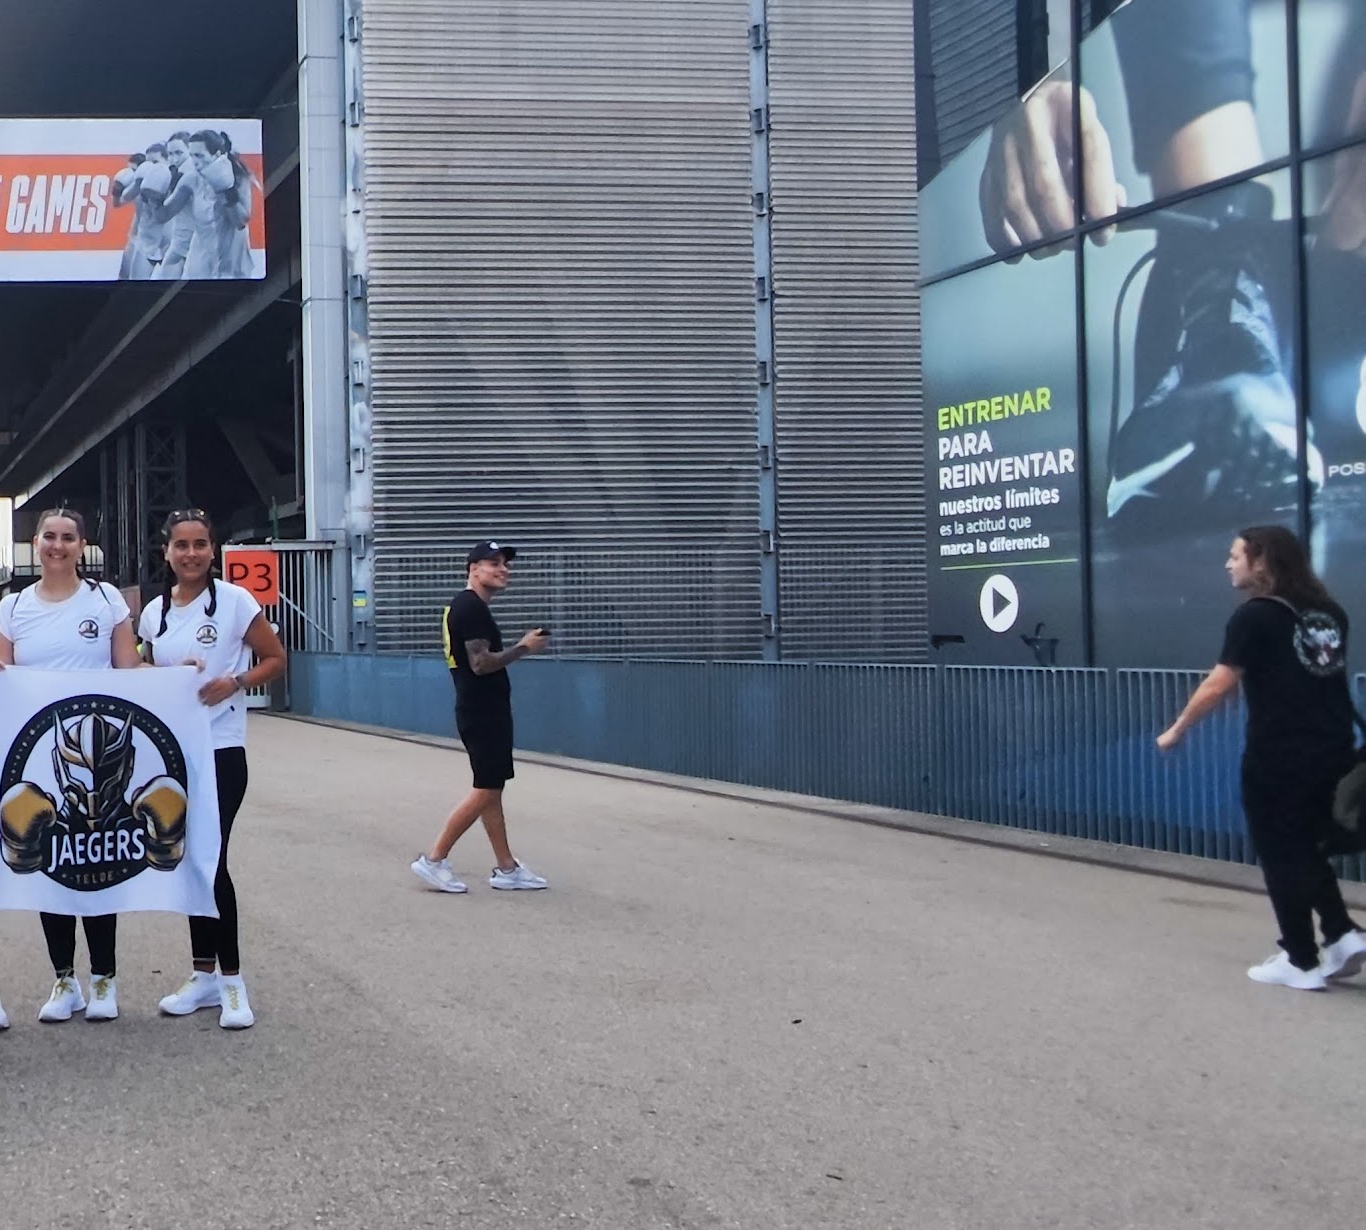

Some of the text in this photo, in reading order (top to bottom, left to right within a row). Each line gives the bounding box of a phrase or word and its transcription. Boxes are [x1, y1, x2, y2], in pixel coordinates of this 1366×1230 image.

[5, 174, 110, 234] GAMES
[937, 387, 1051, 431] ENTRENAR
[938, 430, 993, 461] PARA
[938, 448, 1075, 490] REINVENTAR
[939, 486, 1060, 516] nuestros límites
[939, 515, 1032, 536] es la actitud que
[940, 533, 1051, 556] marca la diferencia
[228, 562, 272, 592] P3
[47, 828, 146, 873] JAEGERS
[75, 871, 115, 885] TELDE
